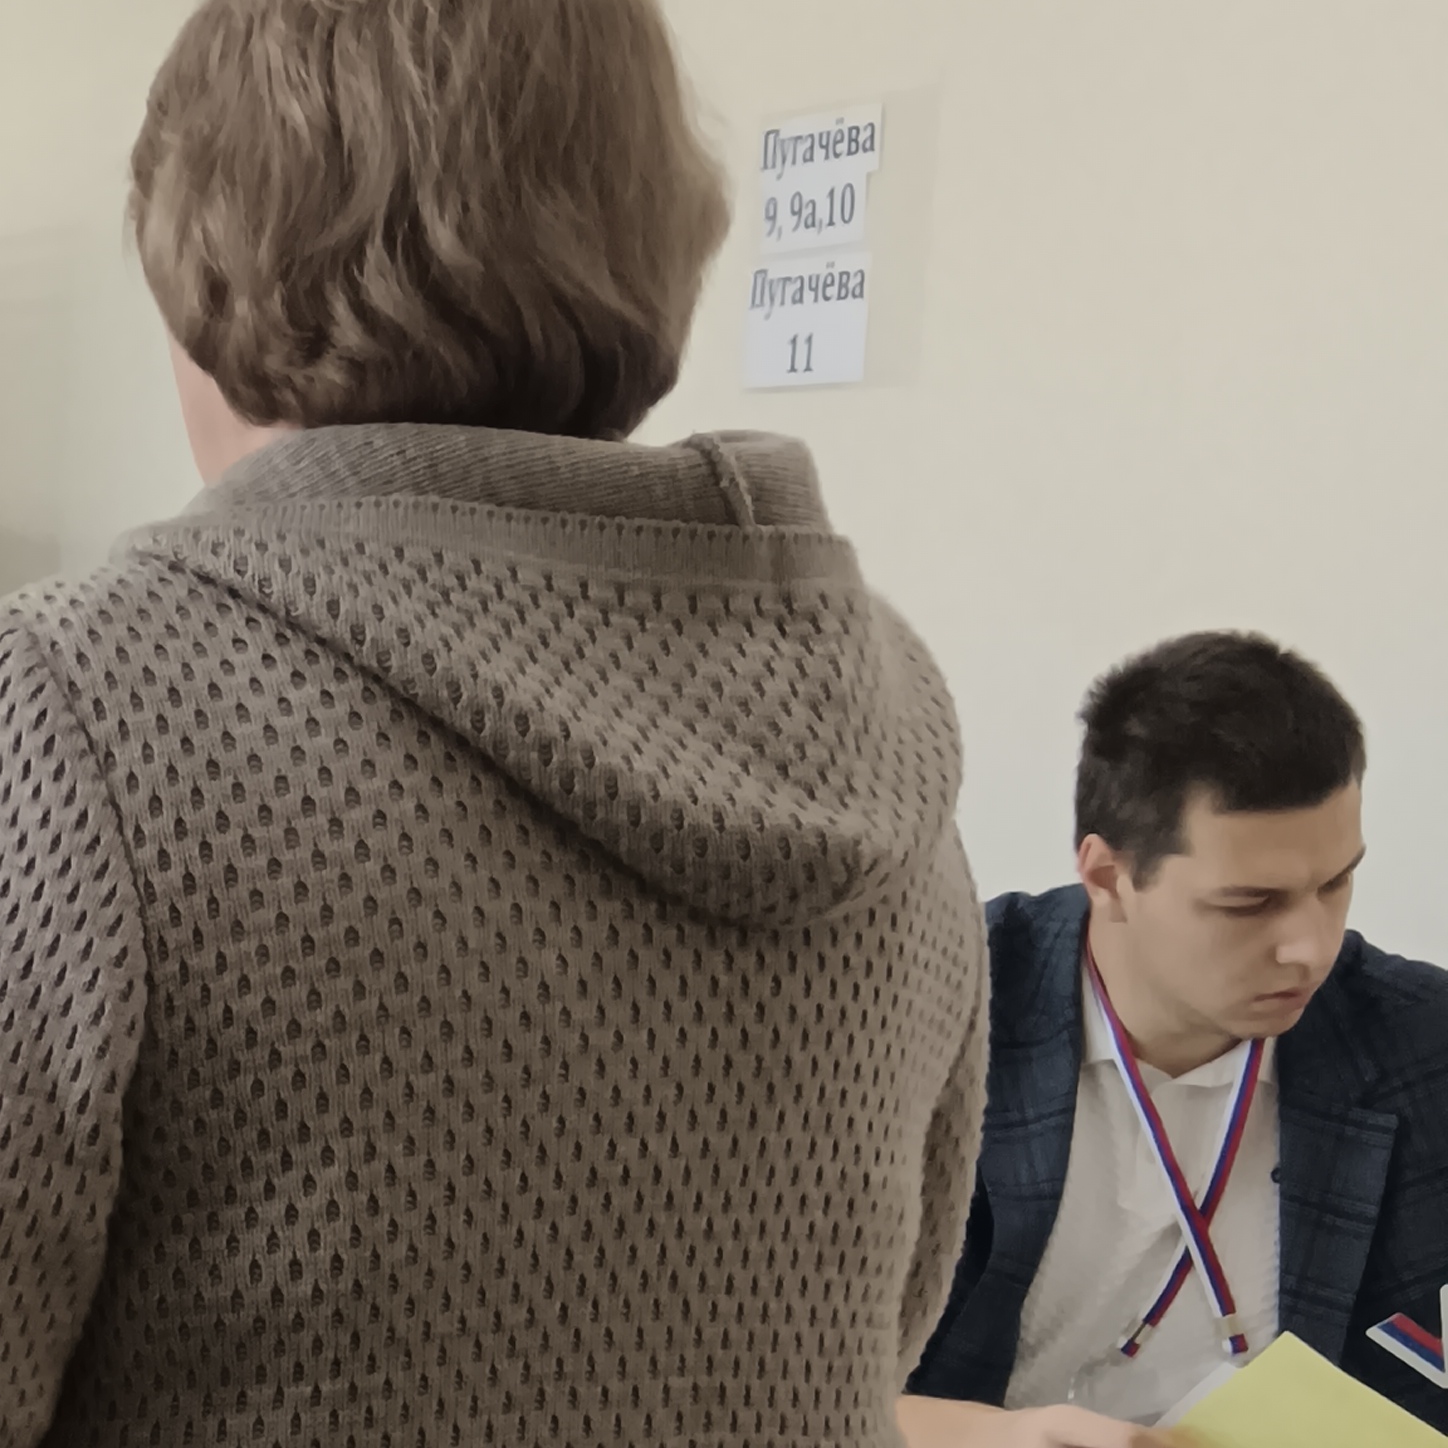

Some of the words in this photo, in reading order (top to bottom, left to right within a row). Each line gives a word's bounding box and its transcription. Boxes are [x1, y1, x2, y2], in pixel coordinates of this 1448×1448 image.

[761, 116, 876, 181] Пугачёва
[764, 196, 783, 242] 9,
[749, 260, 866, 321] Пугачёва
[786, 332, 814, 374] 11
